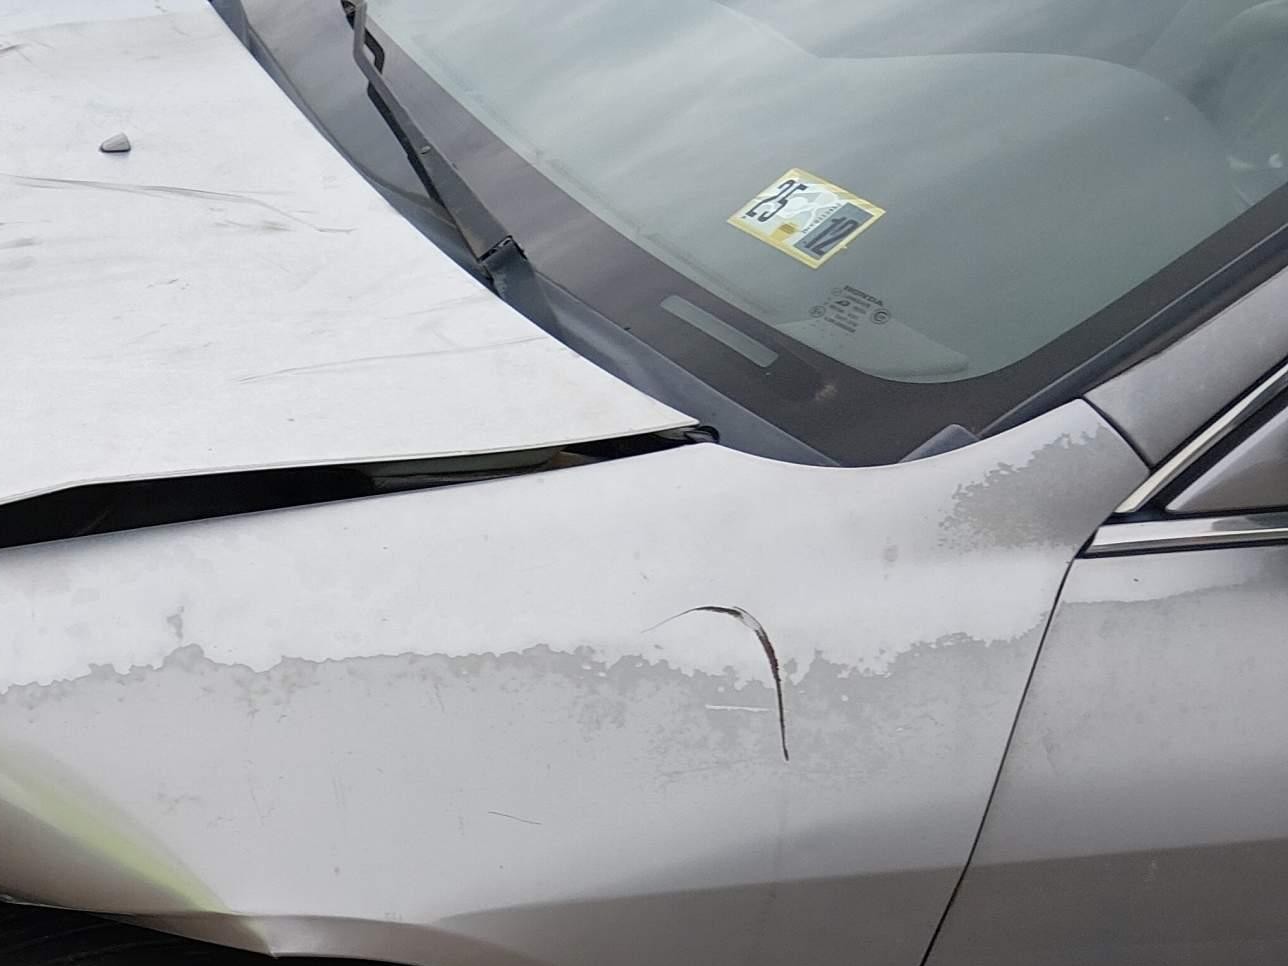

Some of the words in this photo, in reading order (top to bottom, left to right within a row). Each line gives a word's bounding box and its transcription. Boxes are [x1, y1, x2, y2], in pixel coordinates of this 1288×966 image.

[745, 179, 808, 222] 25
[804, 216, 859, 256] 12
[843, 285, 884, 306] HONDA
